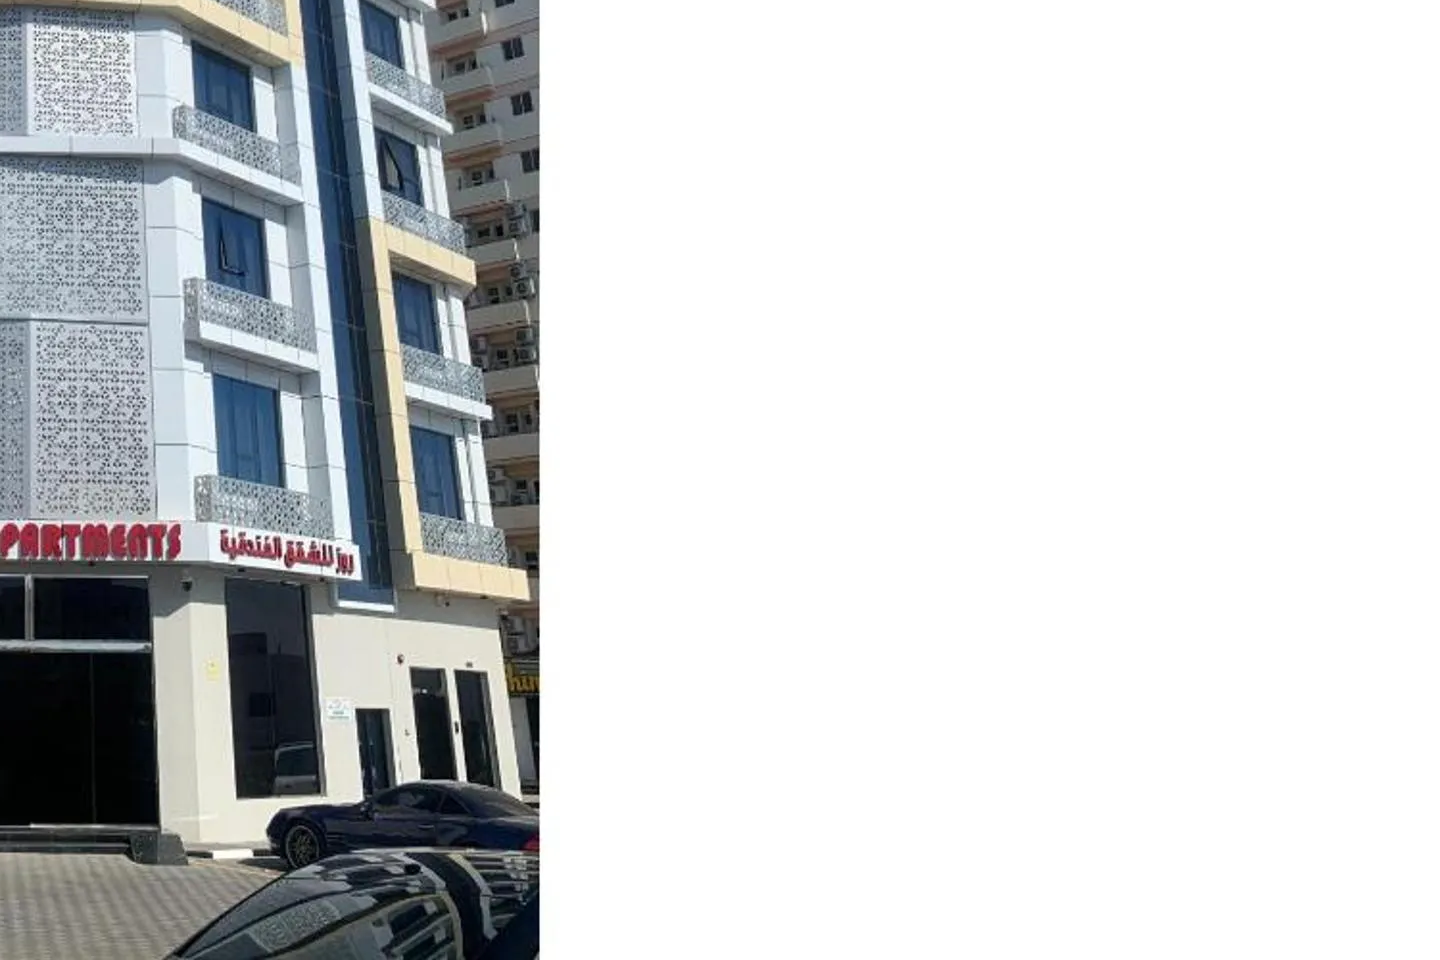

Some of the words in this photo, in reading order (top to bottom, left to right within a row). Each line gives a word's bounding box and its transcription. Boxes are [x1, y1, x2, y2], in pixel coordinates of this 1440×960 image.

[220, 529, 282, 561] الفندقية
[283, 539, 335, 568] للشقق
[335, 546, 354, 574] روز
